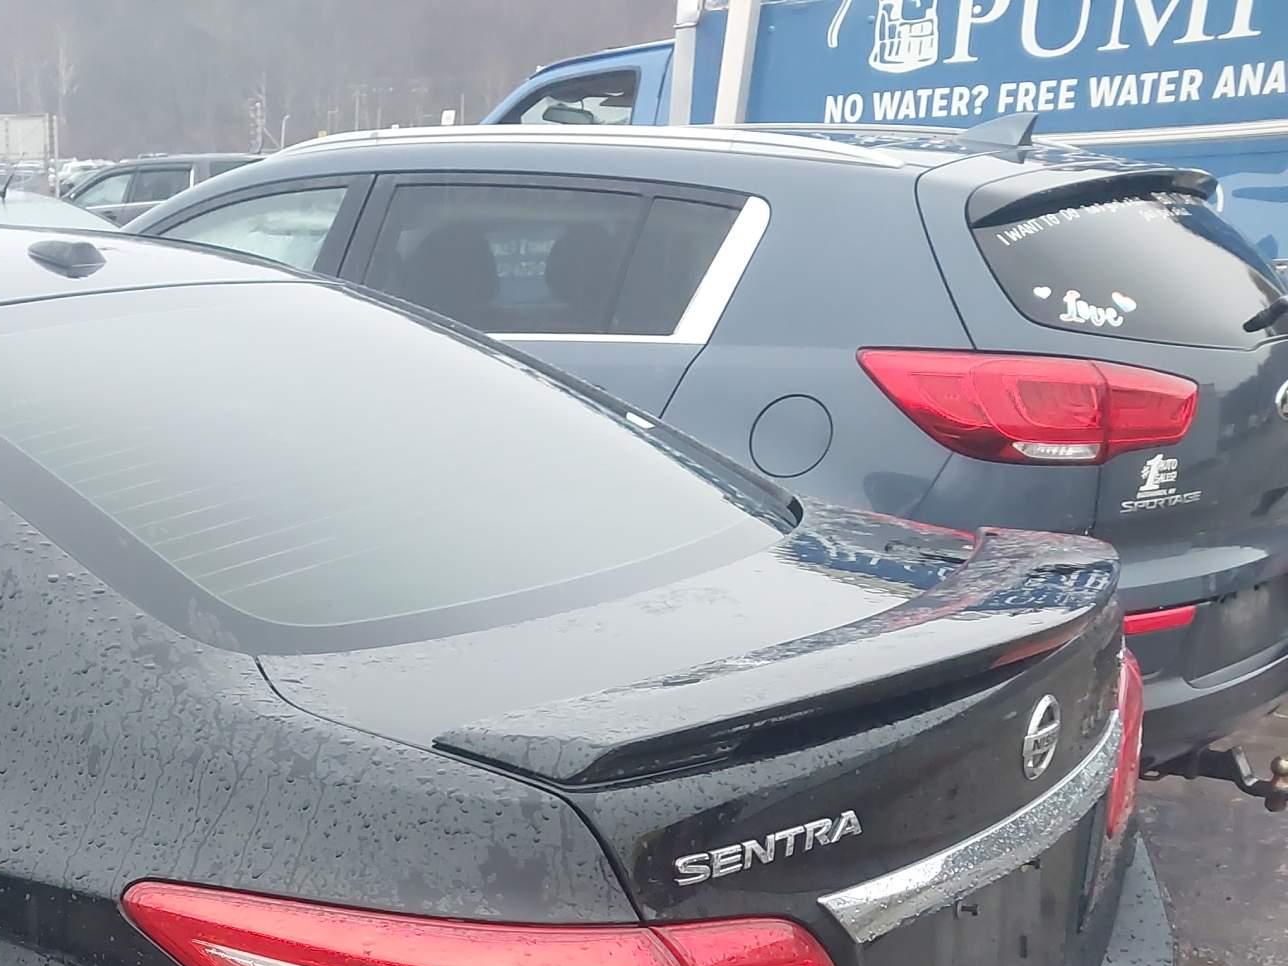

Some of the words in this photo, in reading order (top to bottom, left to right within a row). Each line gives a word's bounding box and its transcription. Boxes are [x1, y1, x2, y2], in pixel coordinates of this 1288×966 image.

[824, 94, 863, 124] NO
[873, 85, 988, 120] WATER?
[997, 78, 1078, 113] FREE
[1089, 69, 1204, 108] WATER
[1004, 218, 1044, 242] WANT
[1120, 490, 1202, 513] SPORTAGE
[674, 810, 862, 886] SENTRA
